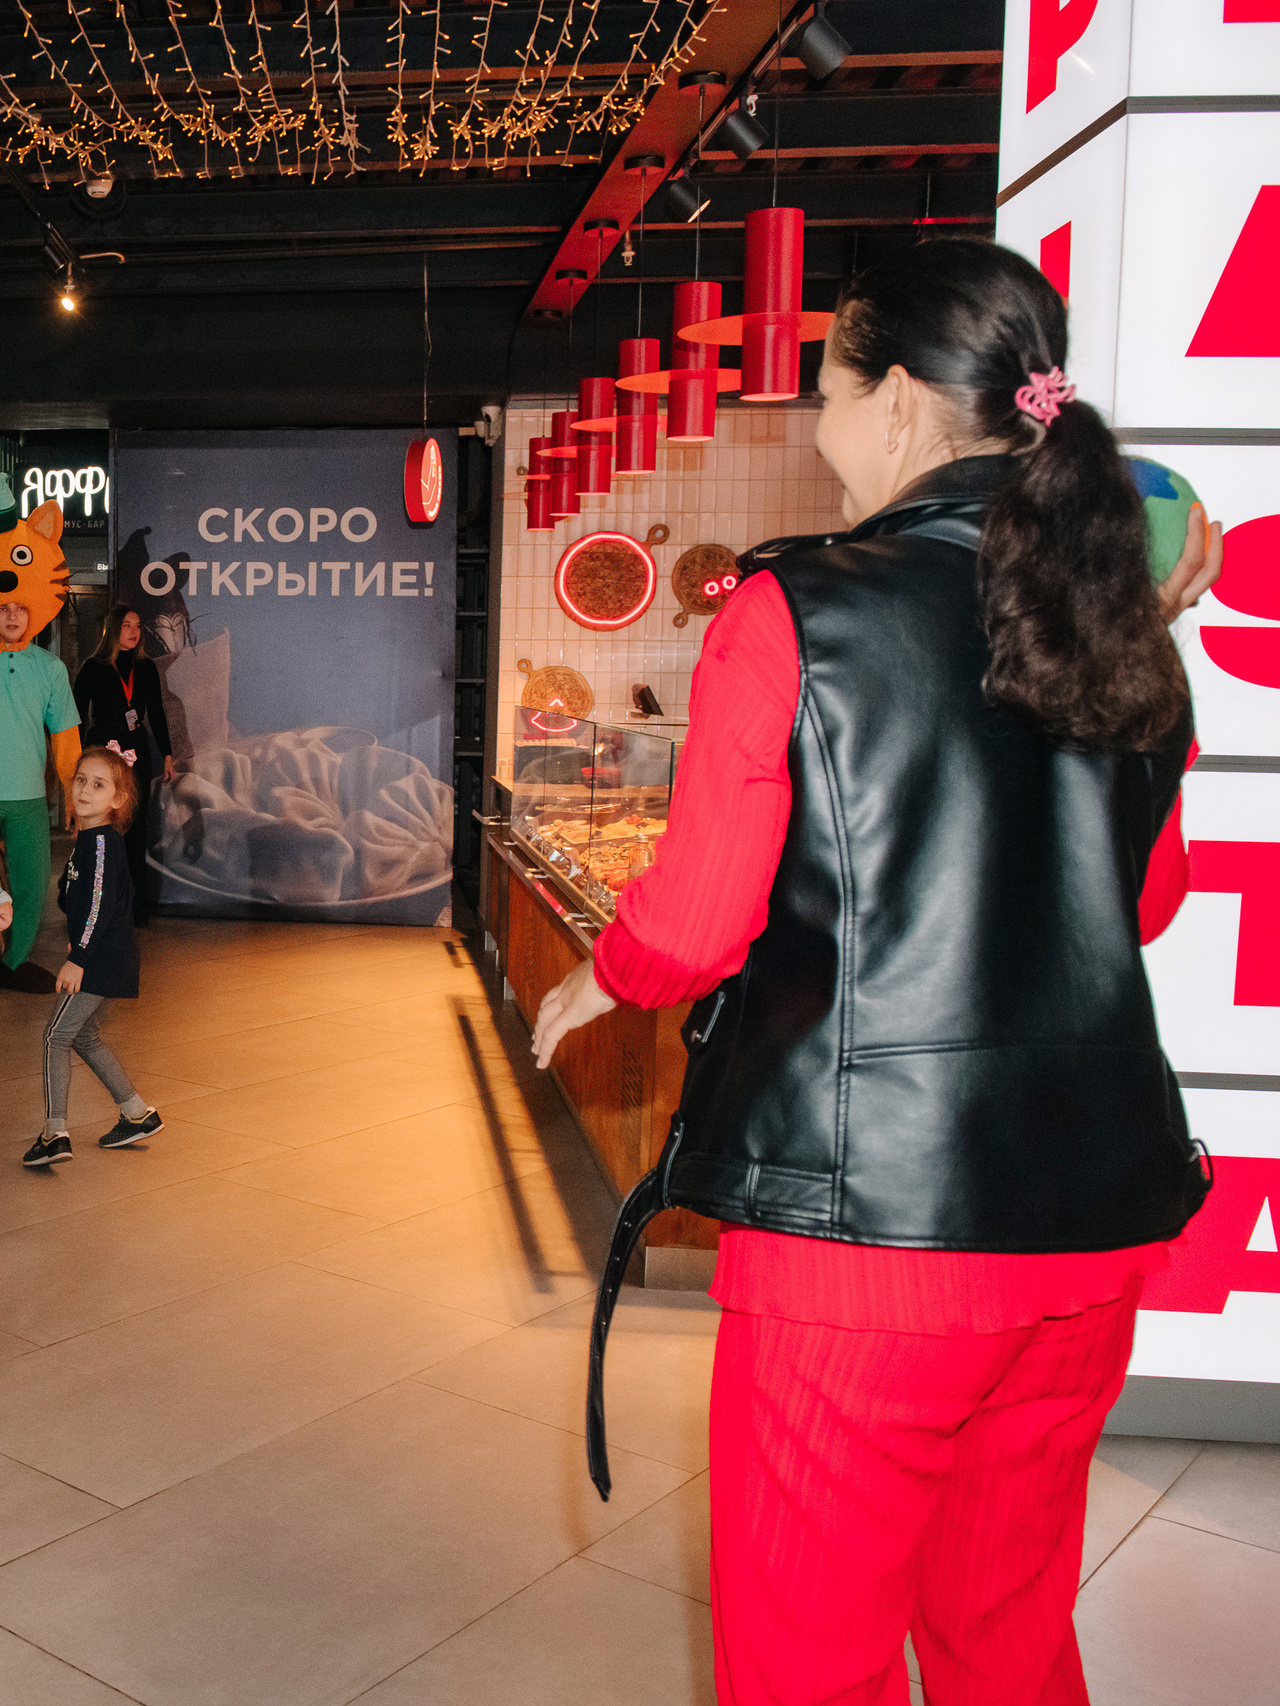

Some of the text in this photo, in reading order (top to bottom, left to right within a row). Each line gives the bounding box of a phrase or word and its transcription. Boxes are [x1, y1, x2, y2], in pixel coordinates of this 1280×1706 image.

[64, 520, 105, 528] МУС-БАР
[197, 506, 378, 543] СКОРО
[140, 561, 435, 597] ОТКРЫТИЕ!
